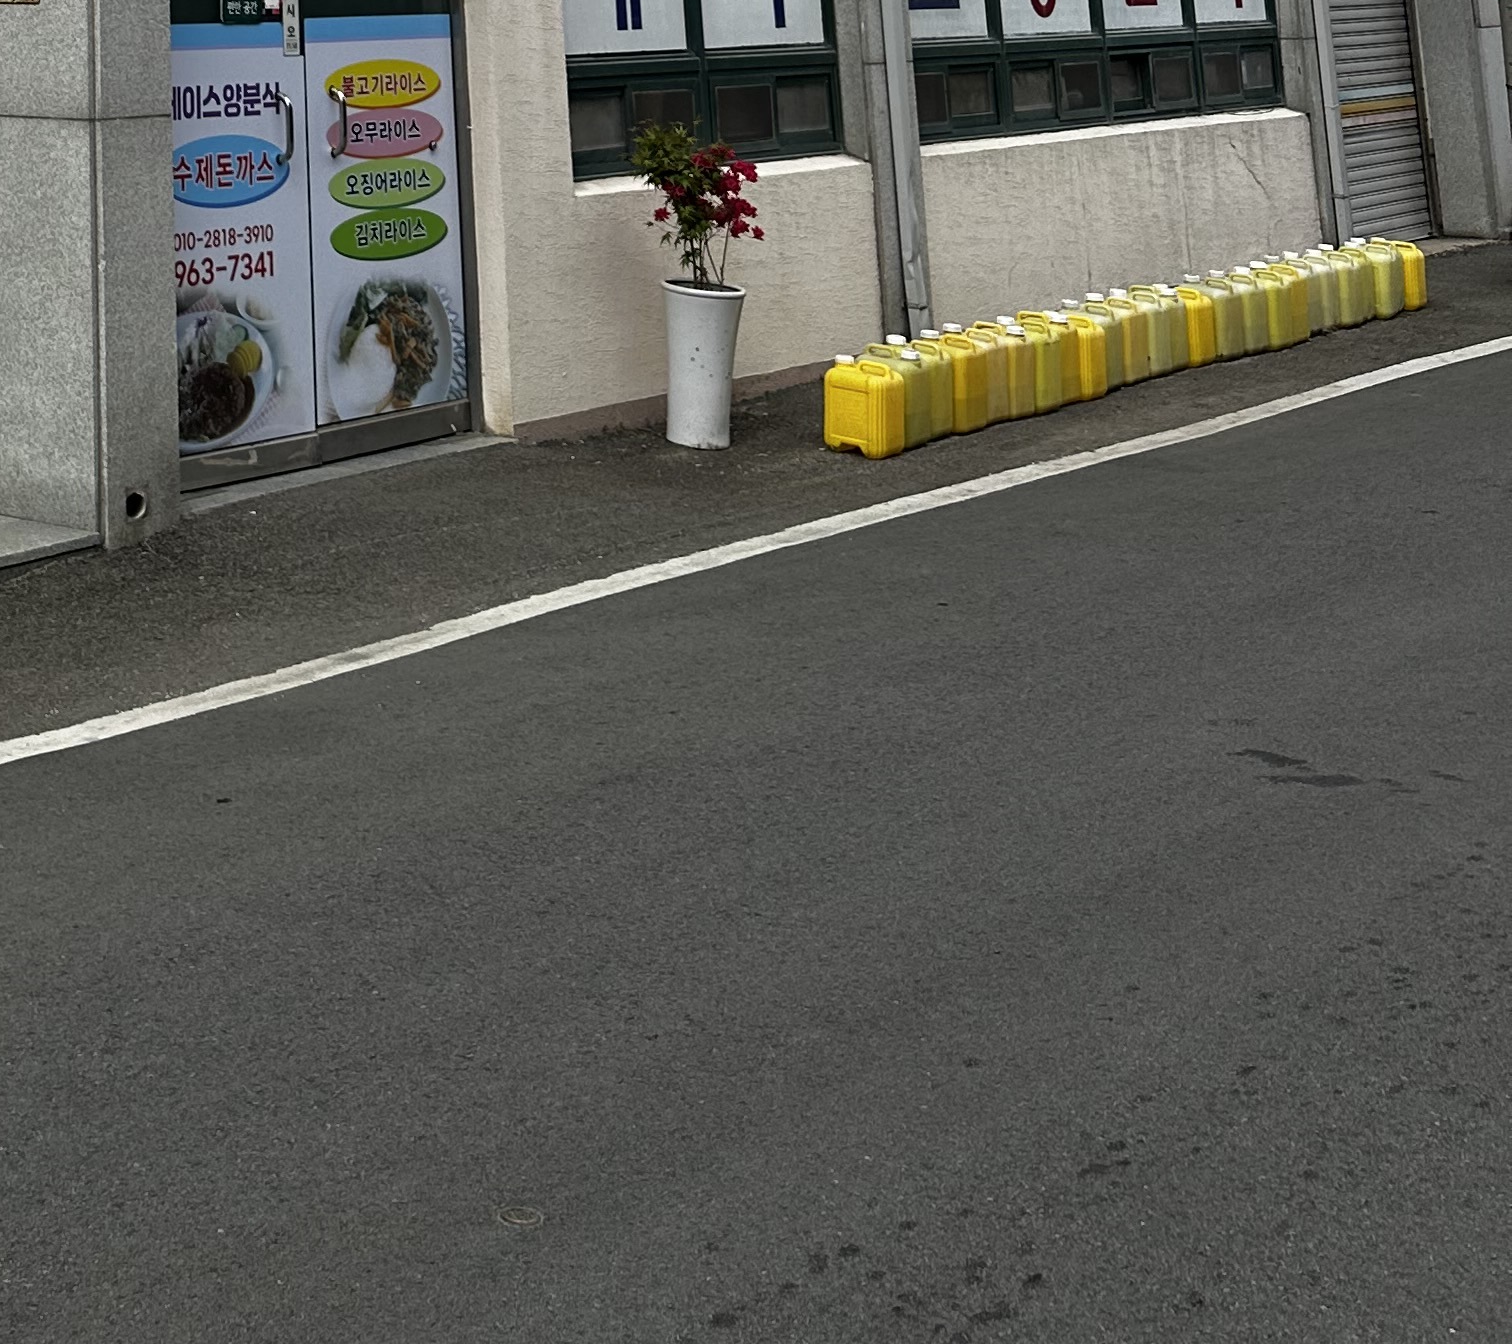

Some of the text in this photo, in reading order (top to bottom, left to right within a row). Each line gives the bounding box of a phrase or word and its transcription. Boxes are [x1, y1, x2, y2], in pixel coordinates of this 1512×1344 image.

[342, 73, 427, 98] 불고기라이스
[350, 119, 422, 144] 오무라이스
[173, 152, 275, 191] 수제돈까스
[346, 168, 431, 196] 오징어라이스
[174, 224, 274, 252] 010-2818-3910
[355, 218, 427, 247] 김치라이스
[175, 251, 274, 288] 963-7341
